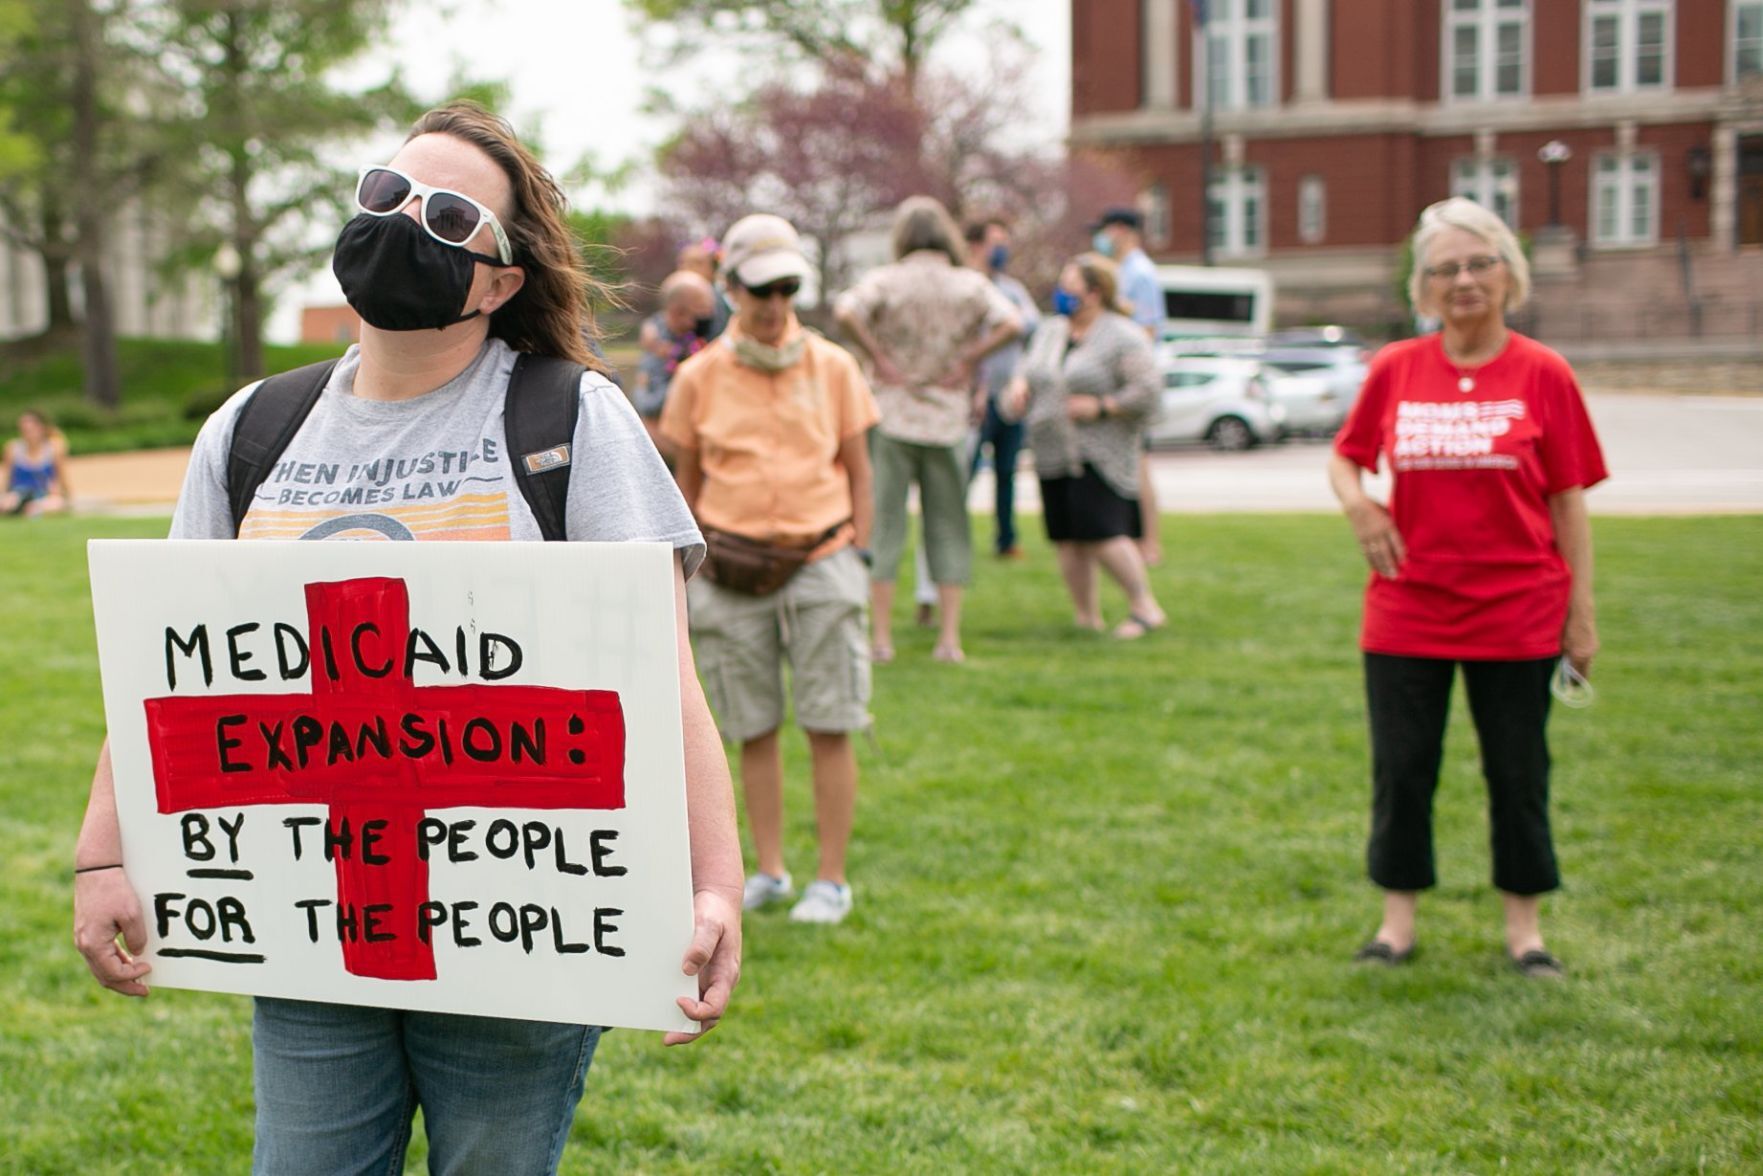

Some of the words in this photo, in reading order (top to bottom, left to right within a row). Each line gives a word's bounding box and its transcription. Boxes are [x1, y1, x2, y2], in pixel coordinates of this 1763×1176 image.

[1395, 435, 1493, 456] ACTION
[1396, 417, 1510, 436] DEMAND
[273, 459, 340, 485] HEN
[278, 485, 396, 506] BECOMES
[402, 480, 463, 500] LAW
[165, 622, 523, 691] MEDICAID
[217, 713, 586, 773] EXPANSION:
[180, 813, 244, 863] BY
[282, 817, 391, 866] THE
[417, 818, 627, 877] PEOPLE
[153, 893, 256, 944] FOR
[294, 899, 396, 943] THE
[418, 901, 626, 957] PEOPLE
